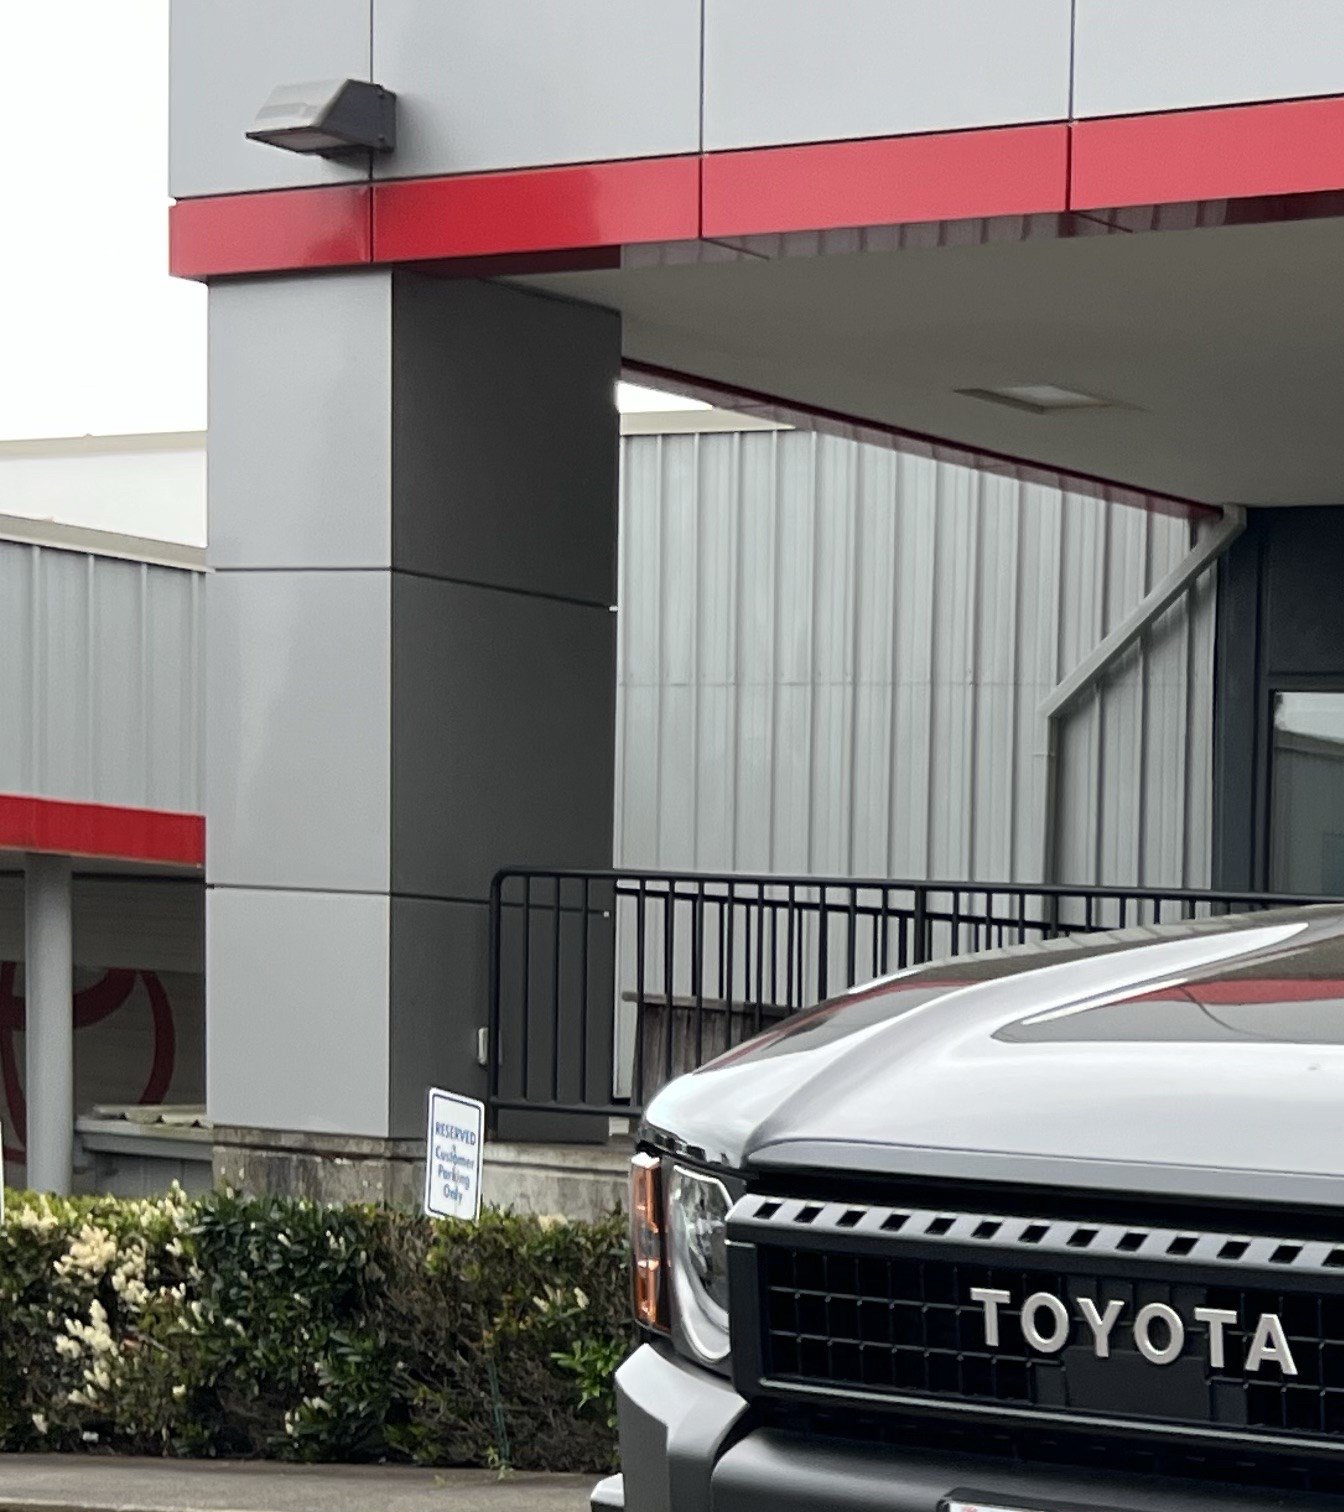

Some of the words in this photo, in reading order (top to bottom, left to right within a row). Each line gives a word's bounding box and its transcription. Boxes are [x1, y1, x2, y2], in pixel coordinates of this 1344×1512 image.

[435, 1121, 477, 1146] RESERVED
[435, 1145, 475, 1170] Customer
[437, 1163, 471, 1190] Parking
[442, 1183, 464, 1206] Only
[968, 1286, 1299, 1376] TOYOTA
